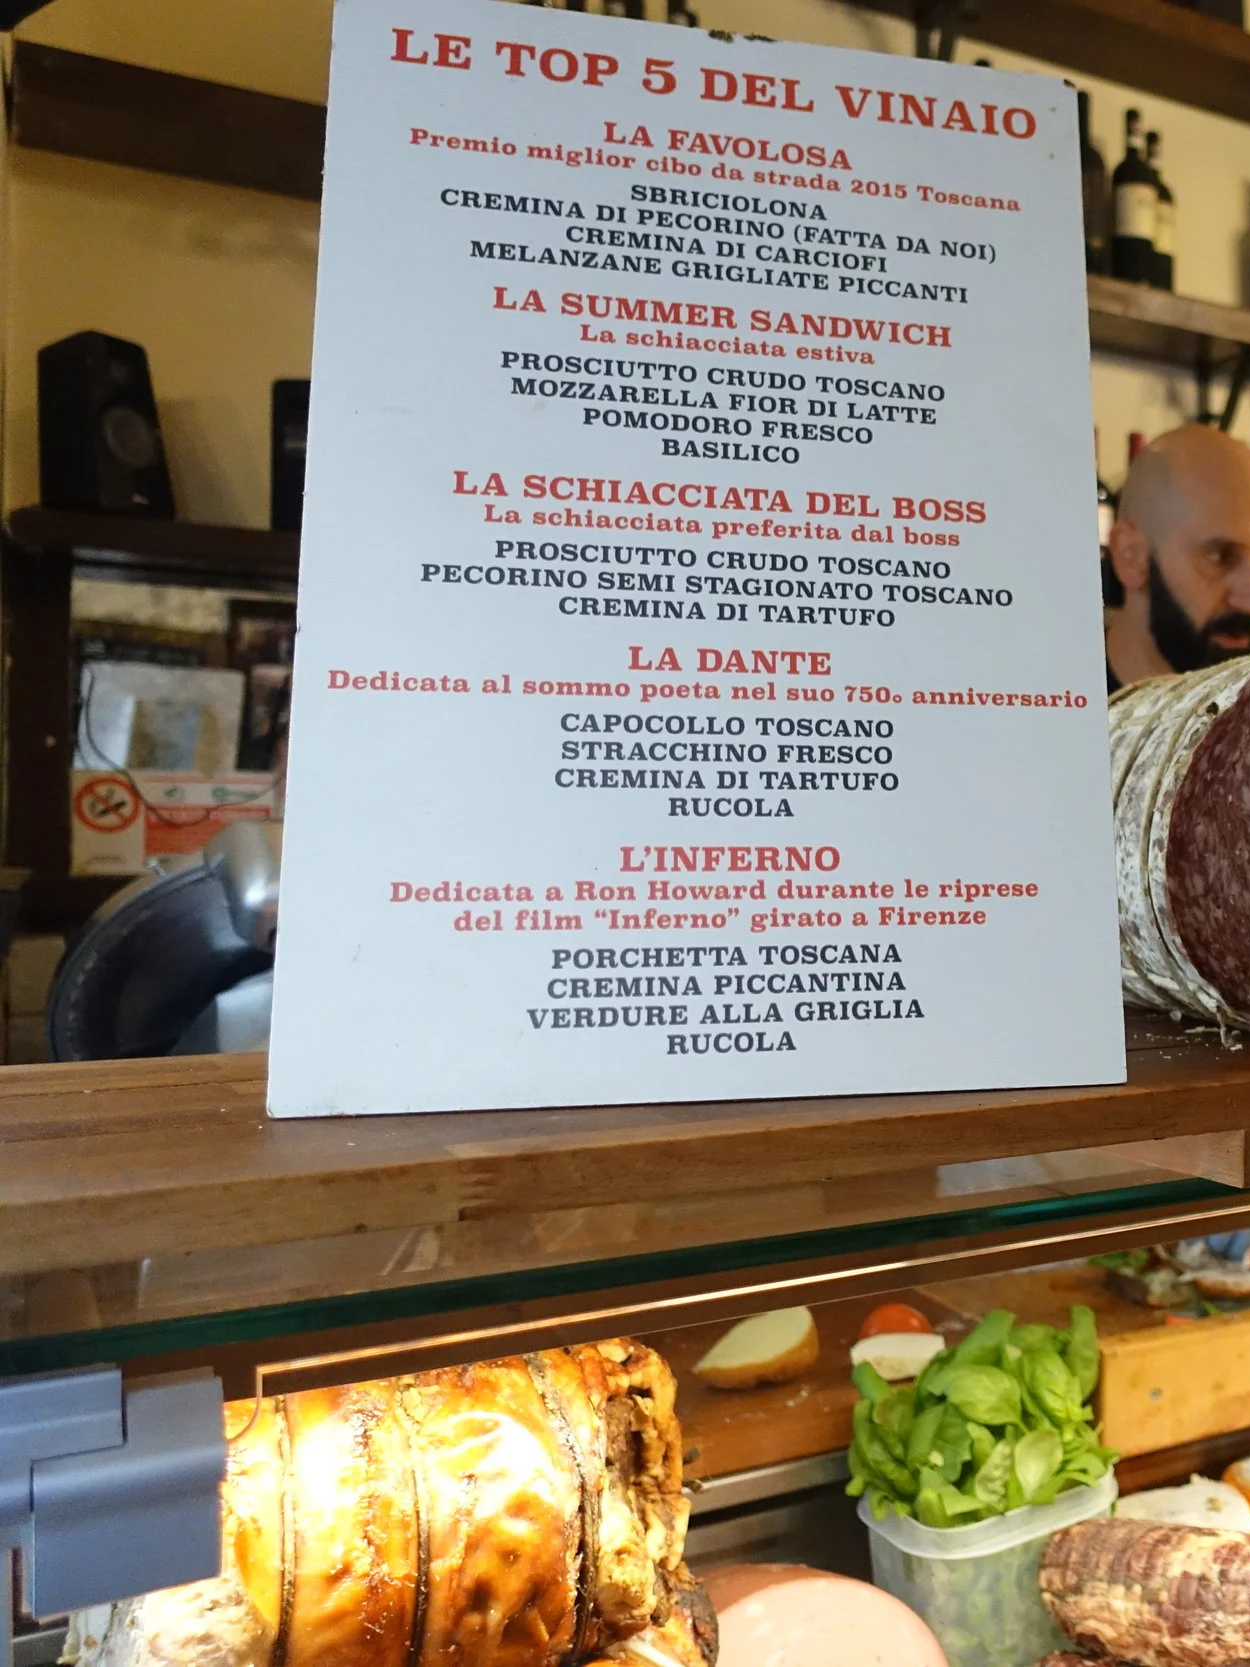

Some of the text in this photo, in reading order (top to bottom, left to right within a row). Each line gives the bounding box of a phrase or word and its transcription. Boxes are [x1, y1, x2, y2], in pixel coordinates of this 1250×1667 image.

[390, 27, 1037, 140] LE TOP 5 DEL VINAIO
[603, 121, 853, 171] LA FAVOLOSA
[409, 127, 1020, 212] Premio miglior cibo da strada 2015 Toscana
[630, 184, 828, 221] SBRICIOLONA
[440, 188, 996, 265] CREMINA DI PECORINO (FATTA DA NOI)
[565, 225, 888, 274] CREMINA DI CARCIOFI
[469, 240, 968, 304] MELANZANE GRIGLIATE PICCANTI
[492, 286, 952, 348] LA SUMMER SANDWICH
[580, 323, 876, 365] La schiacciata estiva
[500, 350, 945, 402] PROSCIUTTO CRUDO TOSCANO
[510, 376, 937, 426] MOZZARELLA FIOR DI LATTE
[582, 407, 874, 445] POMODORO FRESCO
[661, 437, 800, 465] BASILICO
[452, 470, 987, 524] LA SCHIACCIATA DEL BOSS
[483, 503, 961, 547] La schiacciata preferita dal boss
[494, 539, 951, 580] PROSCIUTTO CRUDO TOSCANO
[420, 563, 1013, 607] PECORINO SEMI STAGIONATO TOSCANO
[558, 595, 896, 628] CREMINA DI TARTUFO
[627, 645, 832, 676] LA DANTE
[327, 669, 471, 693] Dedicata
[481, 674, 512, 694] al
[522, 680, 631, 697] sommo
[639, 682, 721, 703] poeta
[731, 681, 777, 701] nel
[786, 687, 835, 703] suo
[911, 687, 1088, 709] anniversario
[560, 712, 894, 739] CAPOCOLLO TOSCANO
[561, 740, 893, 765] STRACCHINO FRESCO
[554, 767, 900, 792] CREMINA DI TARTUFO
[667, 796, 795, 818] RUCOLA
[389, 878, 1039, 903] Dedicata a Ron Howard durante le riprese
[453, 909, 503, 932] del
[515, 909, 583, 931] film
[750, 907, 842, 934] girato
[851, 911, 869, 927] a
[878, 905, 987, 927] Firenze
[551, 943, 903, 970] PORCHETTA TOSCANA
[547, 971, 907, 1000] CREMINA PICCANTINA
[526, 998, 925, 1030] VERDURE ALLA GRIGLIA
[666, 1030, 798, 1056] RUCOLA
